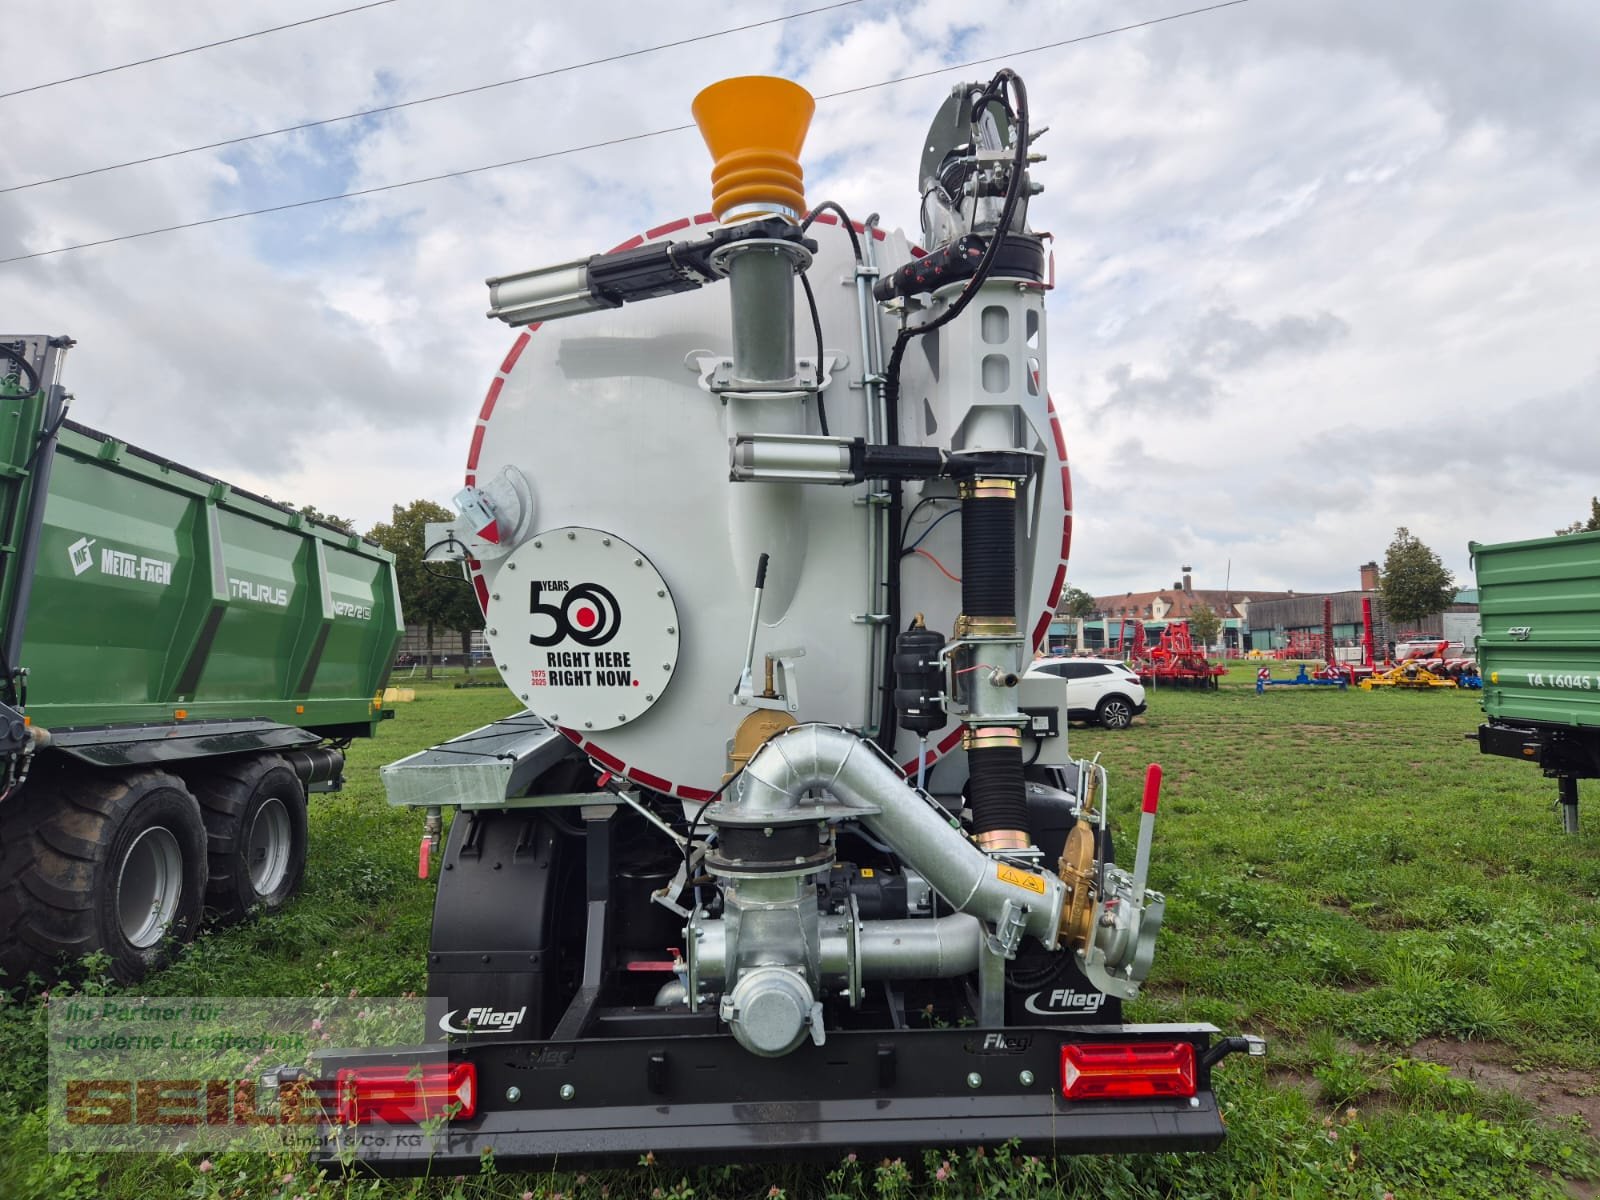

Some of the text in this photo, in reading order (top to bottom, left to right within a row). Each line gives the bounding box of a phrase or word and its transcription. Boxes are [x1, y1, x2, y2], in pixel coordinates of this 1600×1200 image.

[229, 578, 287, 606] TAURUS
[541, 580, 570, 592] YEARS
[529, 580, 621, 647] 50
[547, 652, 631, 668] RIGHT HERE
[531, 670, 546, 678] 1975
[531, 678, 547, 686] 2025
[549, 670, 639, 686] RIGHT NOW.
[1527, 673, 1545, 687] TA
[1549, 674, 1591, 690] 16045
[1049, 988, 1106, 1011] Fliegl
[467, 1006, 527, 1030] Fliegl
